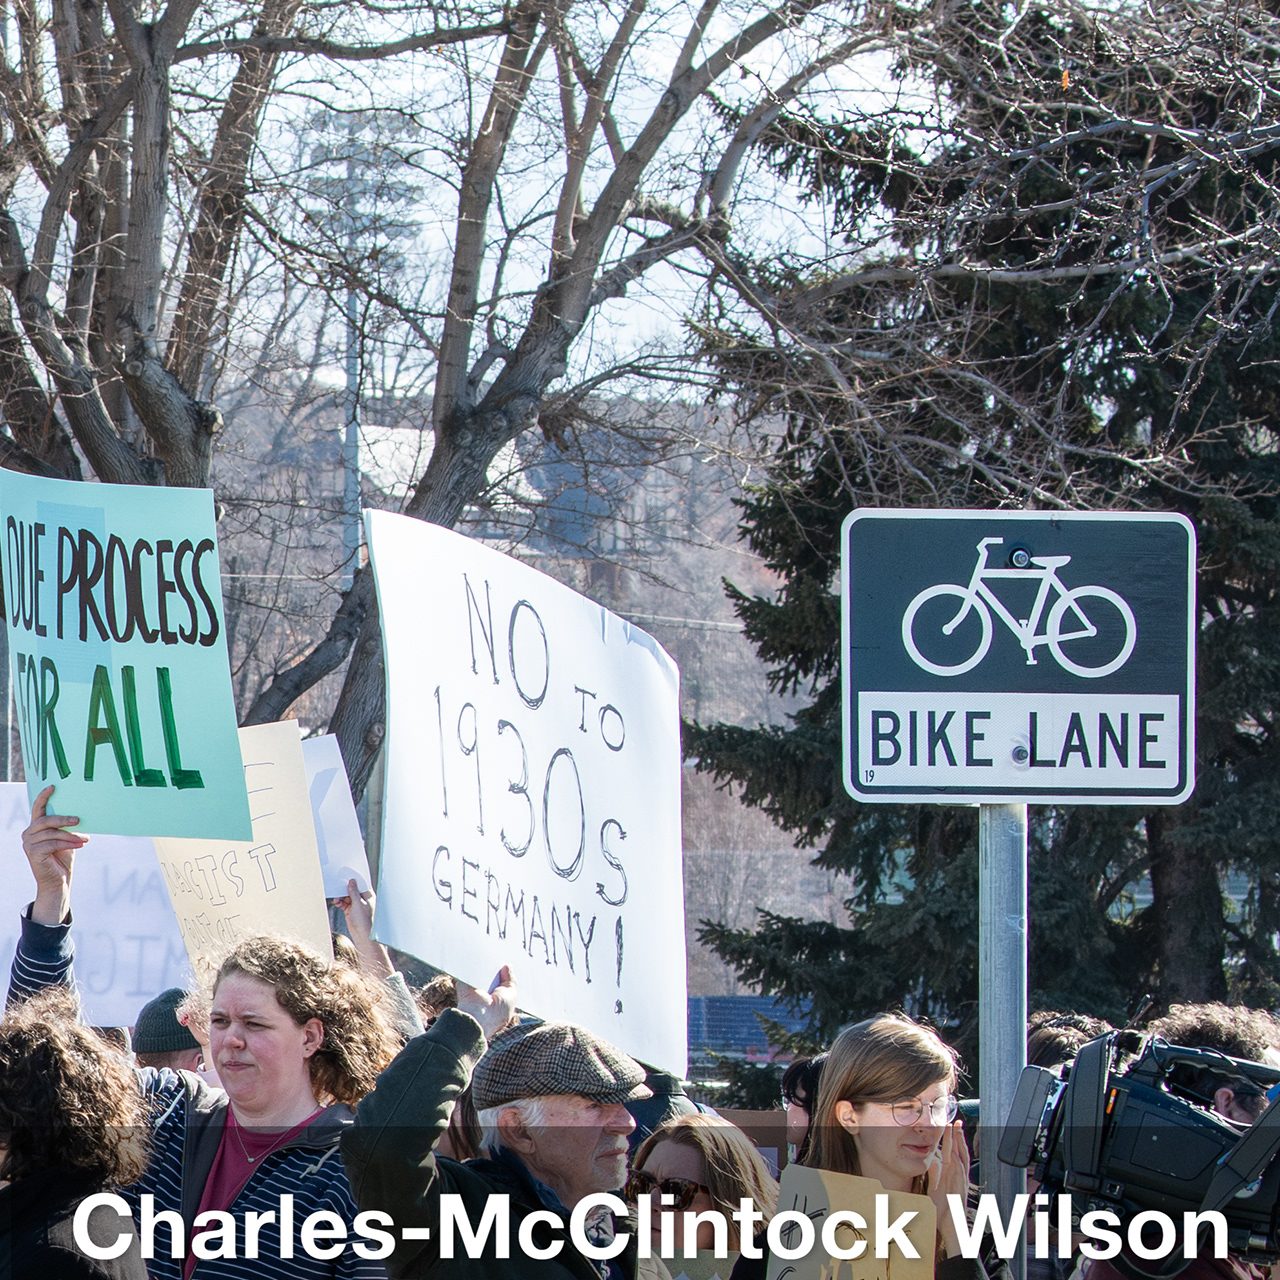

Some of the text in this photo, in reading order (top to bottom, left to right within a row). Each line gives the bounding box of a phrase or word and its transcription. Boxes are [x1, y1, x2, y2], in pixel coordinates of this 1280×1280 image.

[5, 514, 221, 648] DUE PROCESS
[16, 652, 206, 790] FOR ALL
[461, 572, 627, 753] NO TO
[433, 684, 630, 908] 1930S
[864, 769, 876, 784] 19
[870, 710, 1168, 770] BIKE LANE
